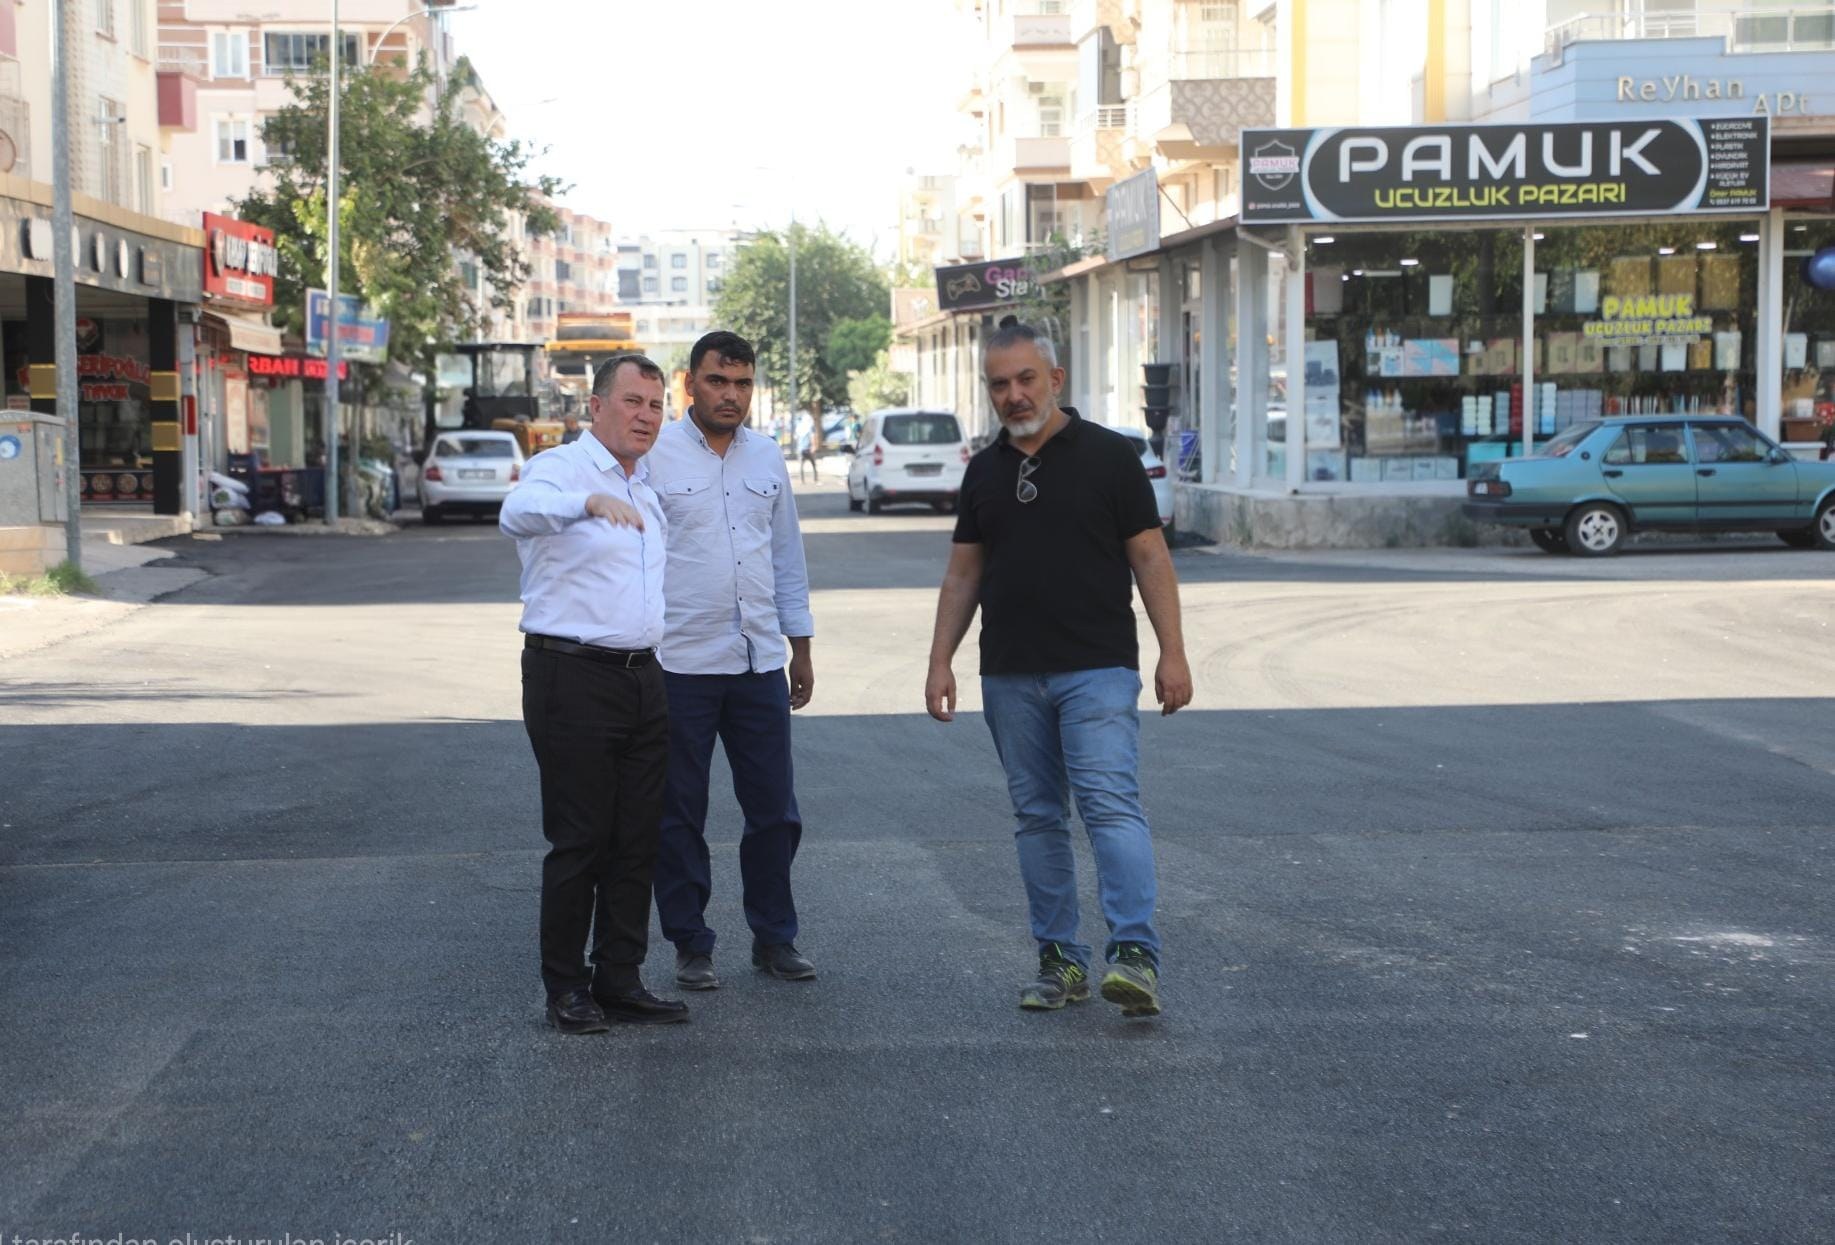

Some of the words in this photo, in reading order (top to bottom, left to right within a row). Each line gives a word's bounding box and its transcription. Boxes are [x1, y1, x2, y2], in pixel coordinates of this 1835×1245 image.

[1338, 128, 1663, 183] PAMUK
[1374, 185, 1510, 208] UCUZLUK
[1519, 183, 1626, 205] PAZARI
[1602, 293, 1695, 320] PAMUK
[1583, 321, 1653, 337] UCUZLUK
